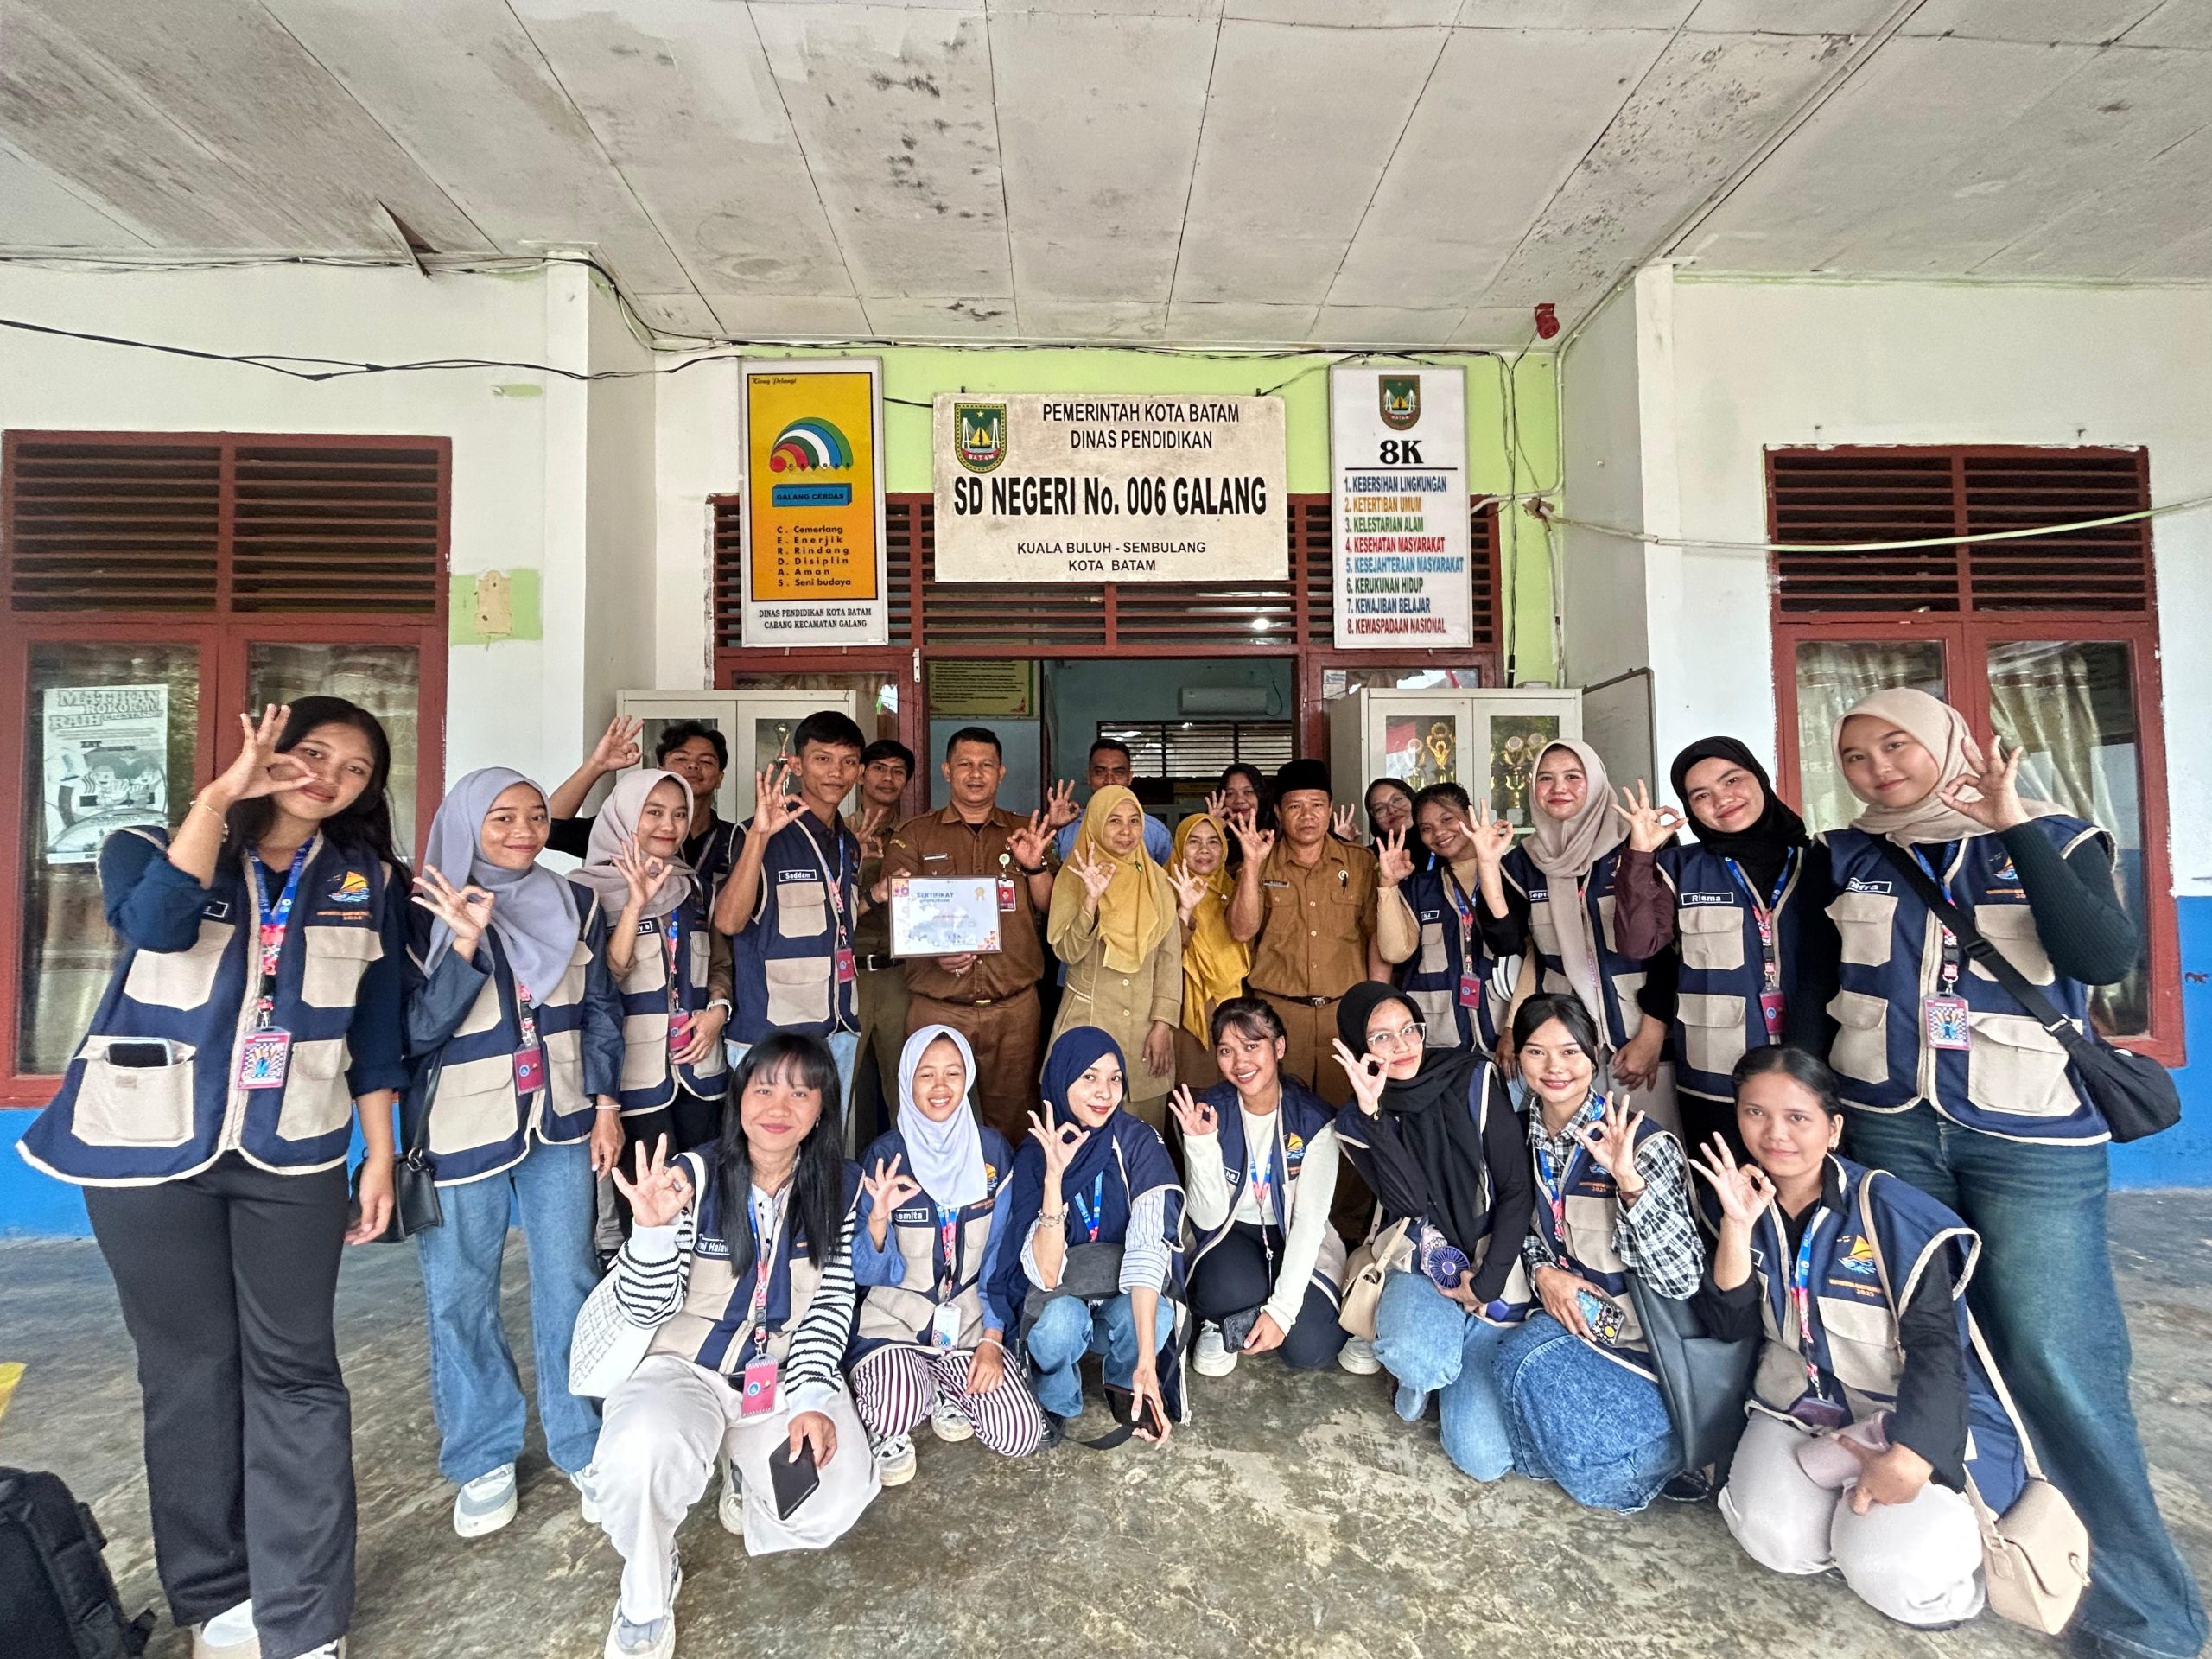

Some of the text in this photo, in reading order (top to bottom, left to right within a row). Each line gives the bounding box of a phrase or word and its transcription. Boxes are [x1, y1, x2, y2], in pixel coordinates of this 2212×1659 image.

[1043, 404, 1239, 423] PEMERINTAH KOTA BATAM
[1071, 430, 1212, 448] DINAS PENDIDIKAN
[1380, 440, 1424, 465] 8K
[1344, 476, 1446, 493] 1. KEBERSIHAN LINGKUNGAN
[954, 476, 1267, 516] SD NEGERI No. 006 GALANG
[1344, 497, 1421, 512] 2. KETERTIBAN UMUM
[793, 525, 843, 534] Cemerlang
[1345, 517, 1424, 532] 3. KELESTARIAN ALAM
[794, 536, 843, 546] Enerjik
[1017, 543, 1063, 554] KUALA
[1066, 543, 1111, 554] BULUH
[1122, 542, 1206, 554] SEMBULANG
[1345, 537, 1445, 553] 4. KESEHATAN MASYARAKAT
[794, 547, 849, 556] Rindang
[794, 557, 849, 566] Disiplin
[1069, 559, 1156, 571] KOTA BATAM
[1346, 557, 1464, 573] 5. KESEJAHTERAAN MASYARAKAT
[817, 578, 851, 587] budaya
[1346, 577, 1424, 594] 6. KERUKUNAN HIDUP
[1347, 597, 1431, 613] 7. KEWAJIBAN BELAJAR
[759, 609, 780, 618] DINAS
[839, 620, 867, 628] GALANG
[1347, 618, 1446, 634] 8. KEWASPADAAN NASIONAL
[85, 702, 159, 714] ROKOKMU
[49, 714, 102, 731] RAIH
